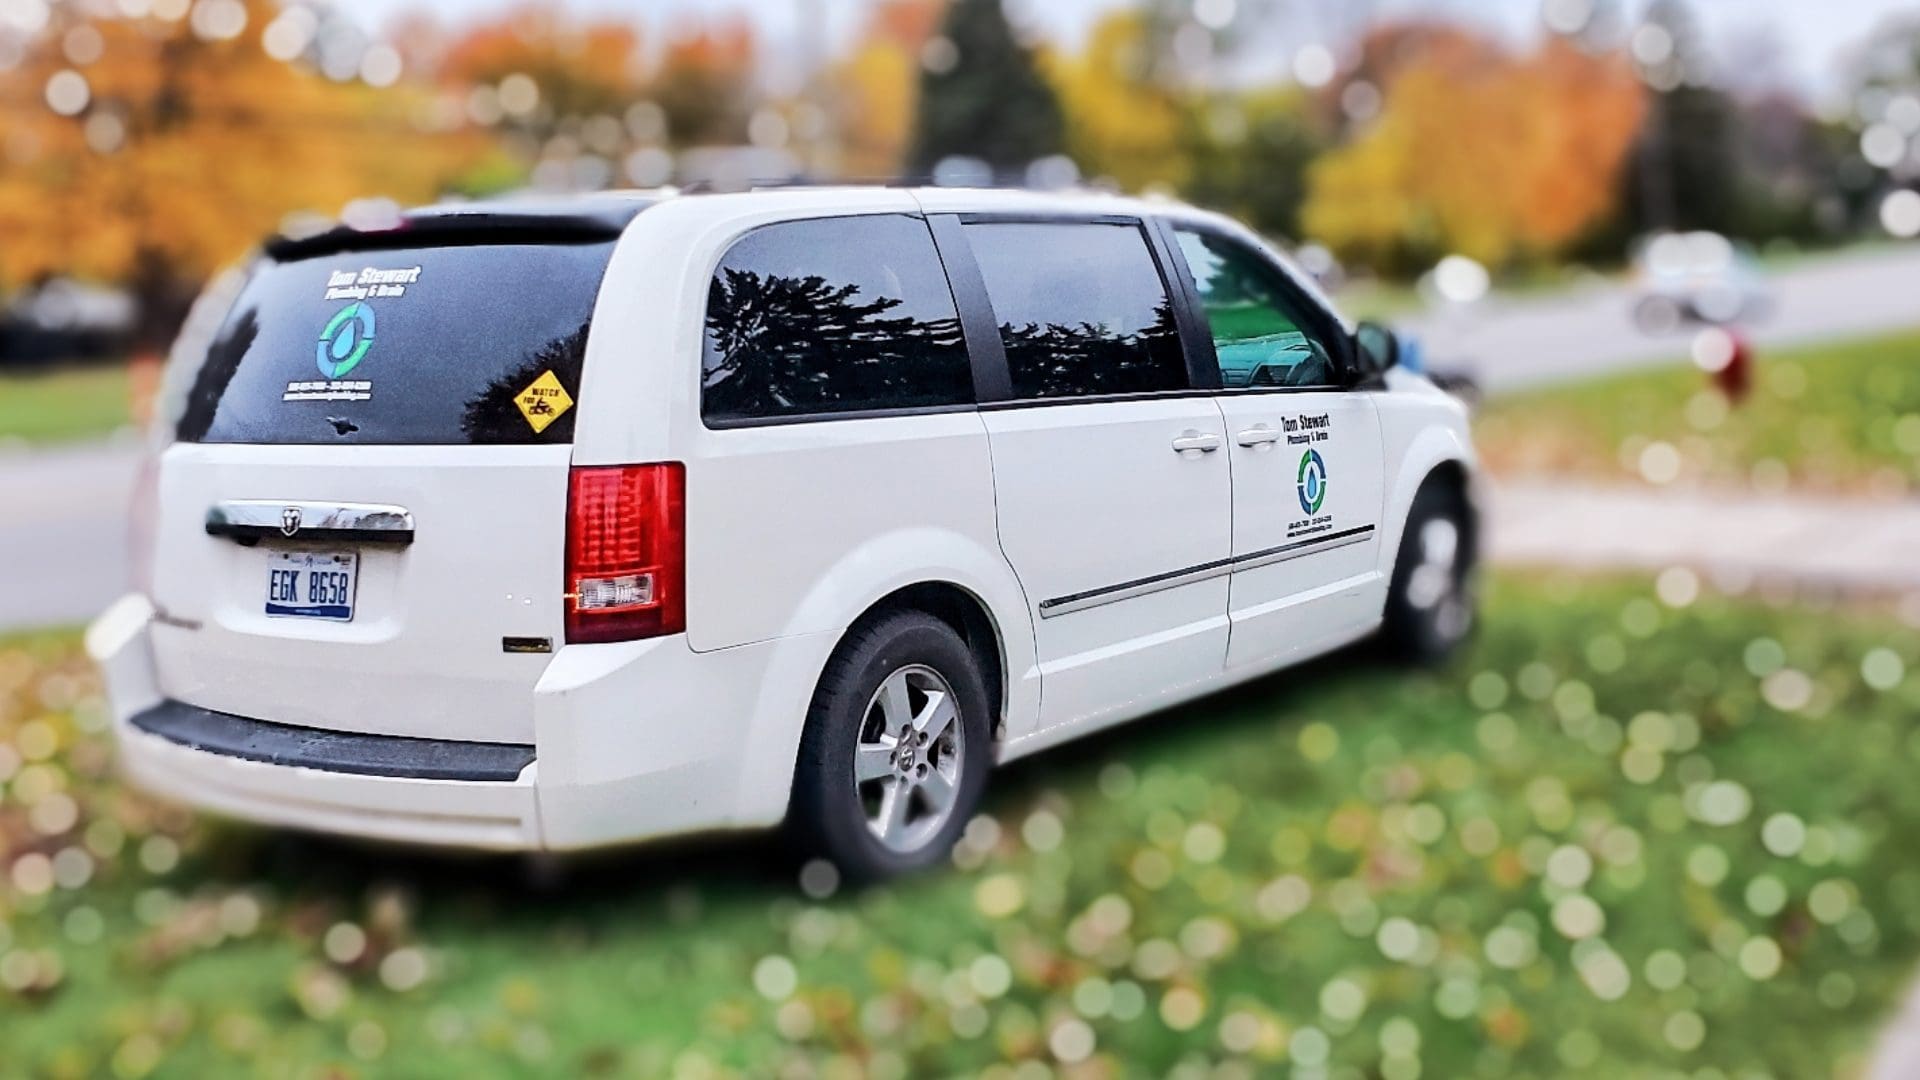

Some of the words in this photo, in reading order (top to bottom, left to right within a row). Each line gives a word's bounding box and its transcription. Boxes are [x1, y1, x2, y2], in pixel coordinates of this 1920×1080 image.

[329, 270, 358, 286] Tom
[358, 265, 421, 284] Stewart
[532, 388, 560, 397] WATCH
[1281, 416, 1298, 432] Tom
[1299, 412, 1330, 430] Stewart
[270, 569, 299, 602] EGK
[309, 571, 348, 604] 8658
